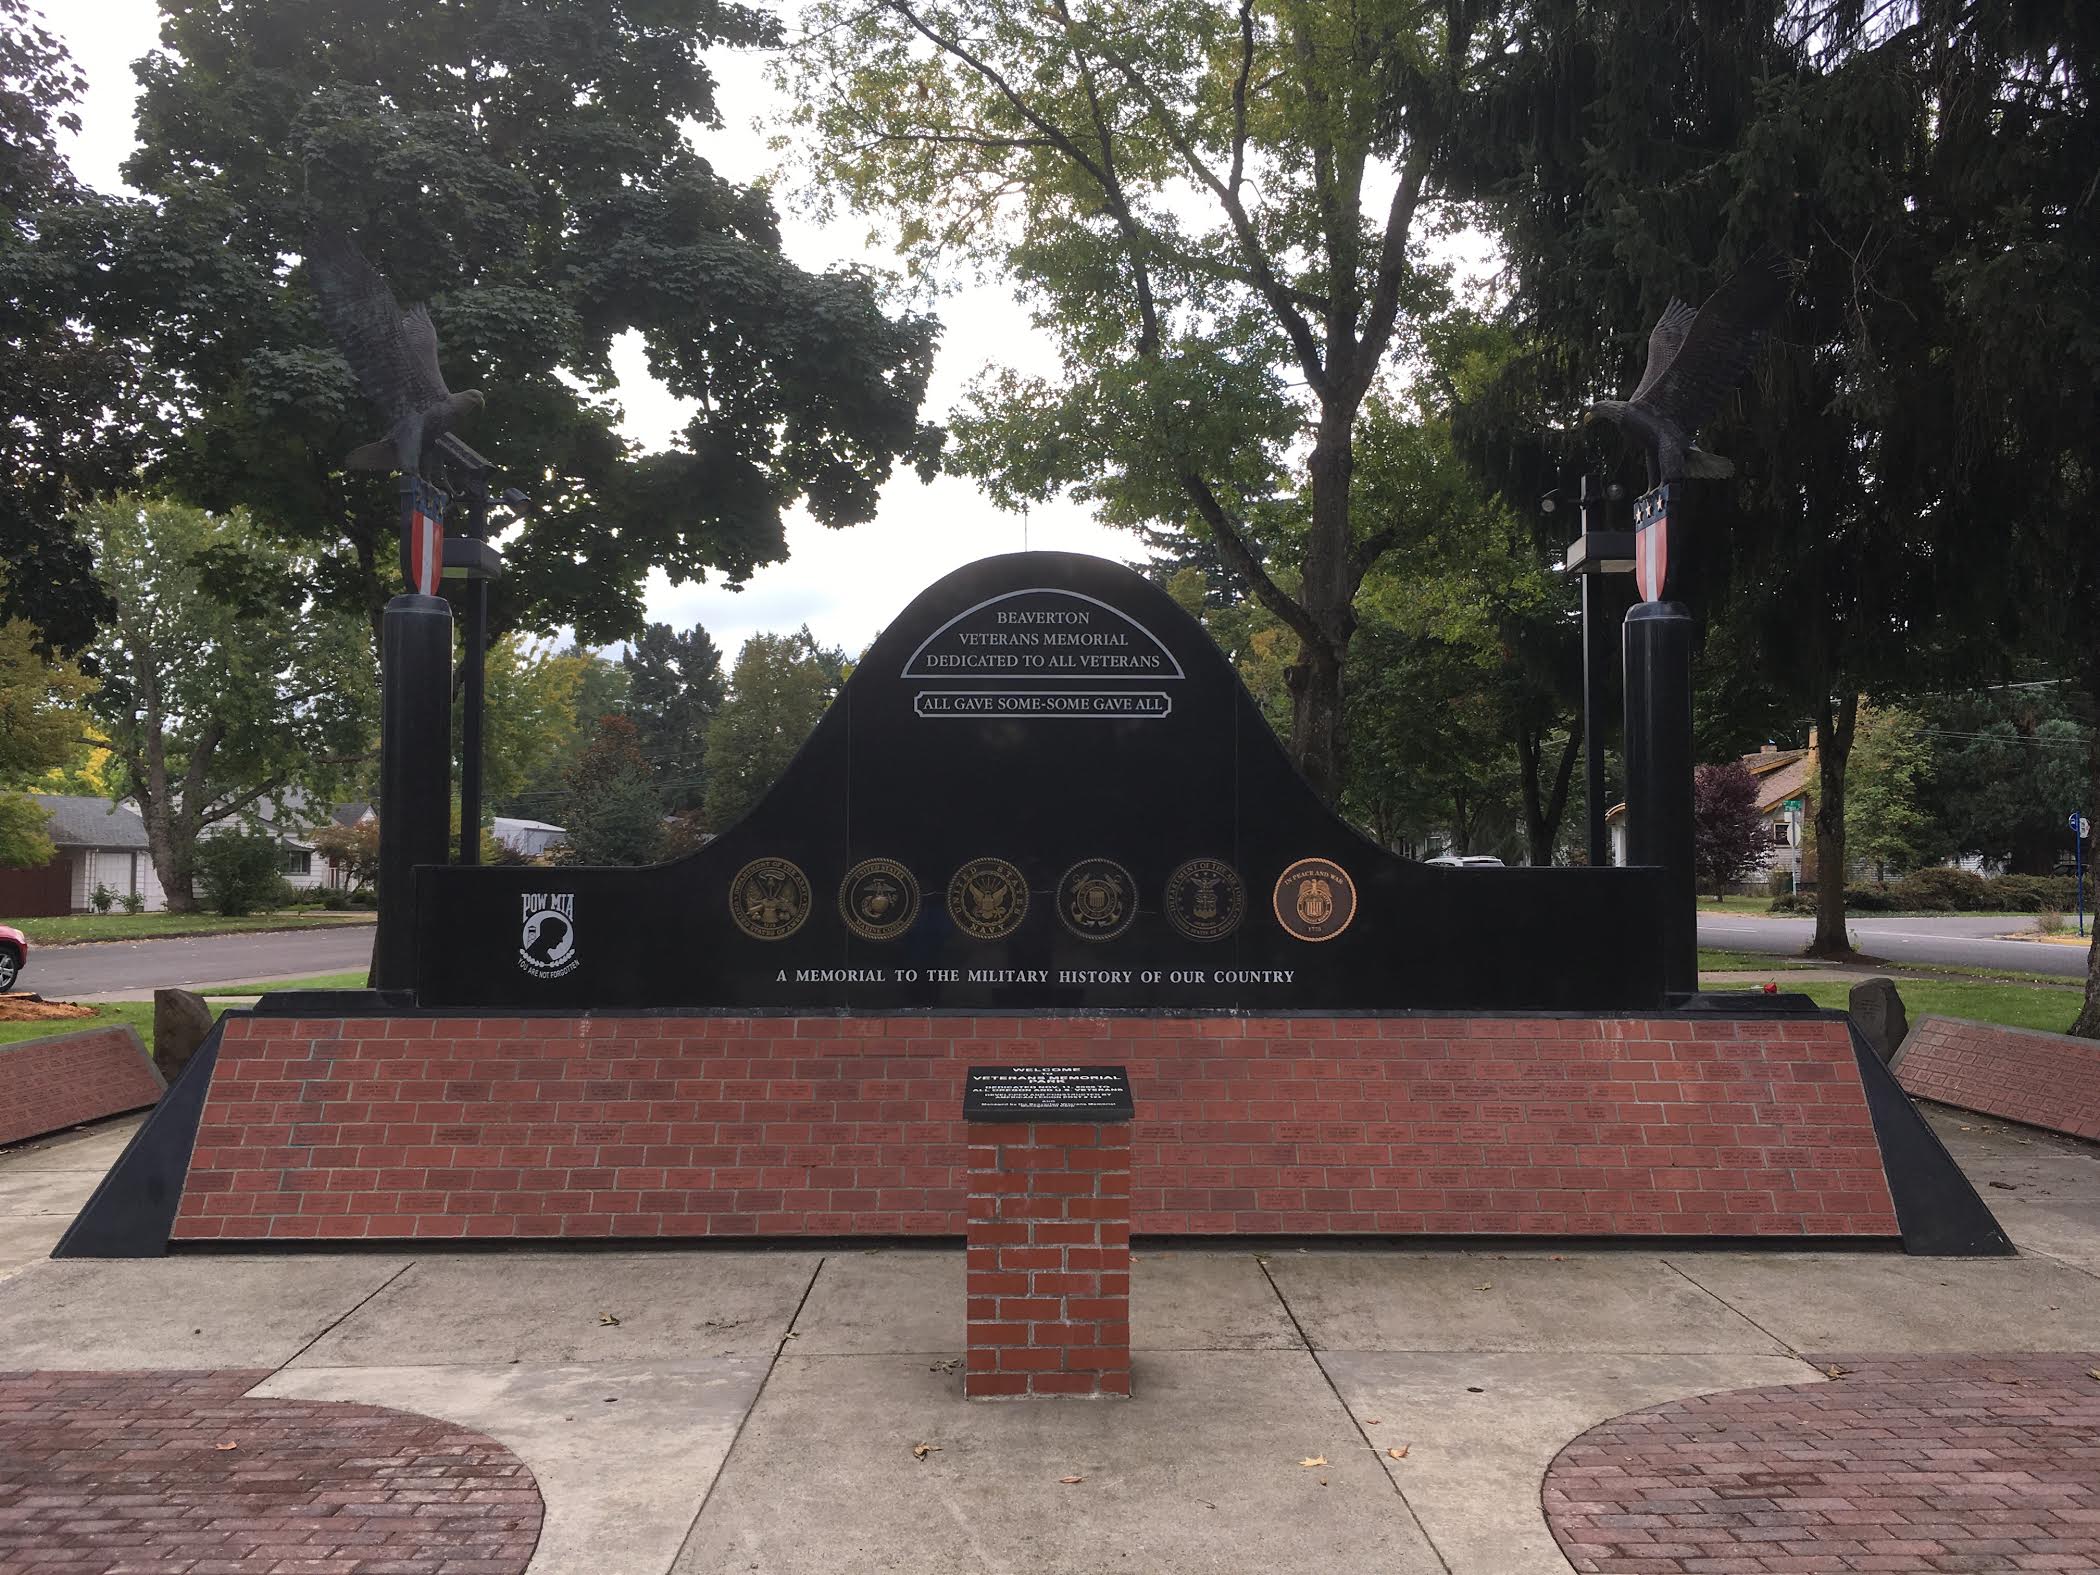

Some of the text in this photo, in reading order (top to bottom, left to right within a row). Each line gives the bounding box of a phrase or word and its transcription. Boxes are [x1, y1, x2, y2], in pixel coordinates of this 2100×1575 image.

[997, 611, 1090, 625] BEAVERTON
[958, 633, 1129, 646] VETERANS MEMORIAL
[926, 654, 1160, 668] DEDICATED TO ALL VETERANS
[923, 697, 1163, 711] ALL GAVE SOME-SOME GAVE ALL
[854, 864, 905, 880] UNITED STATES
[1284, 877, 1293, 885] IN
[1293, 870, 1314, 880] PEACE
[1330, 873, 1344, 885] WAR
[952, 866, 977, 914] UNITED
[996, 865, 1024, 916] STATES
[1168, 864, 1198, 912] DEPARTMENT
[1211, 863, 1227, 873] THE
[521, 893, 575, 923] POW MIA
[971, 923, 1005, 934] NAVY
[517, 958, 581, 979] YOU ARE NOT FORGOTTEN
[776, 969, 1295, 984] A MEMORIAL TO THE MILITARY HISTORY OF OUR COUNTRY
